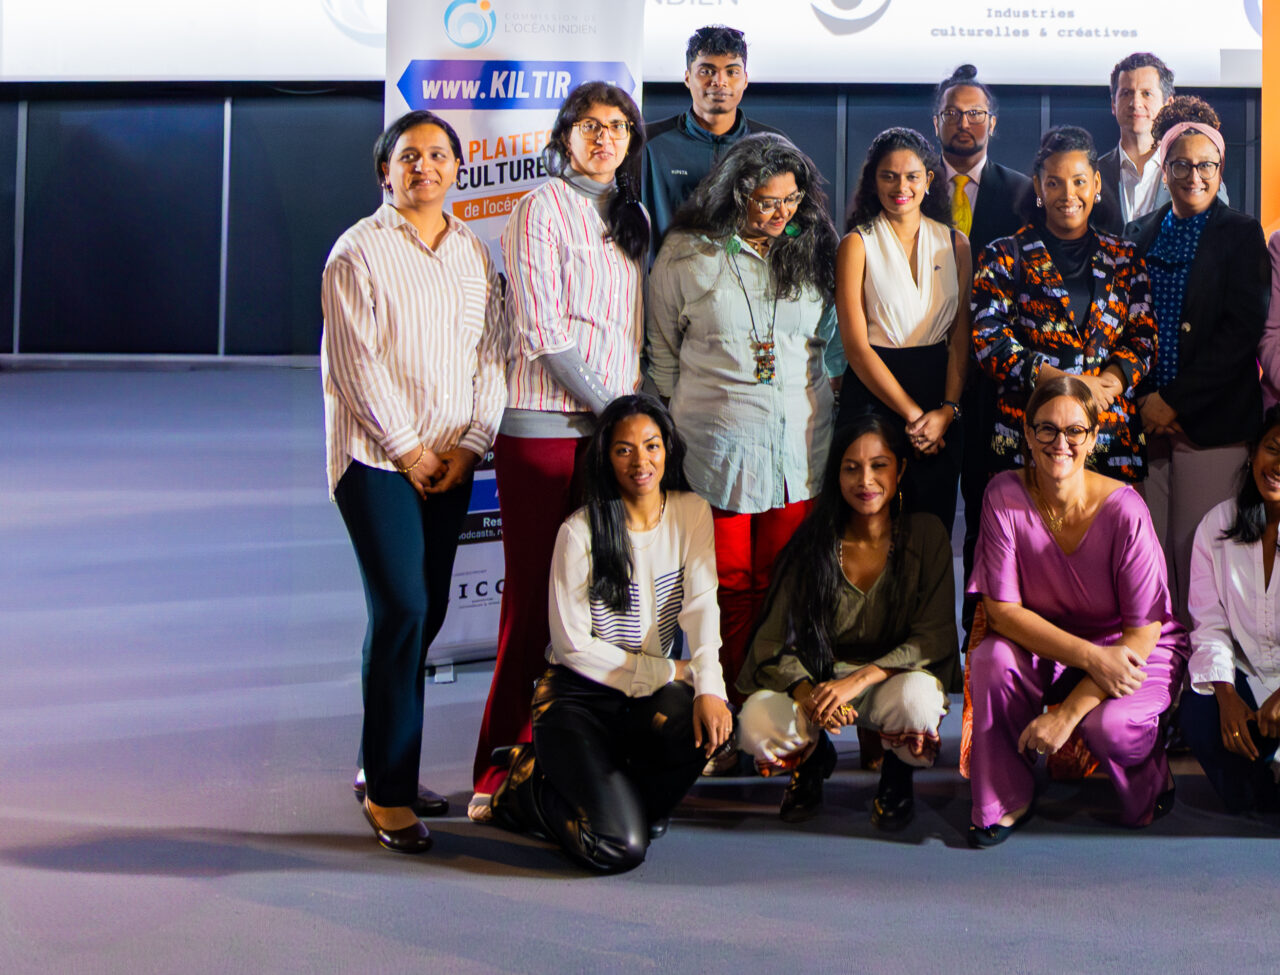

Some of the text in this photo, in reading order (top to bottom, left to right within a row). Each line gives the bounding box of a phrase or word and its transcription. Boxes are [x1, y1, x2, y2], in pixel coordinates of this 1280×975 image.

[986, 8, 1075, 19] Industries
[558, 24, 597, 35] INDIEN
[930, 27, 1030, 38] culturelles
[1057, 26, 1138, 38] créatives
[464, 203, 479, 218] de
